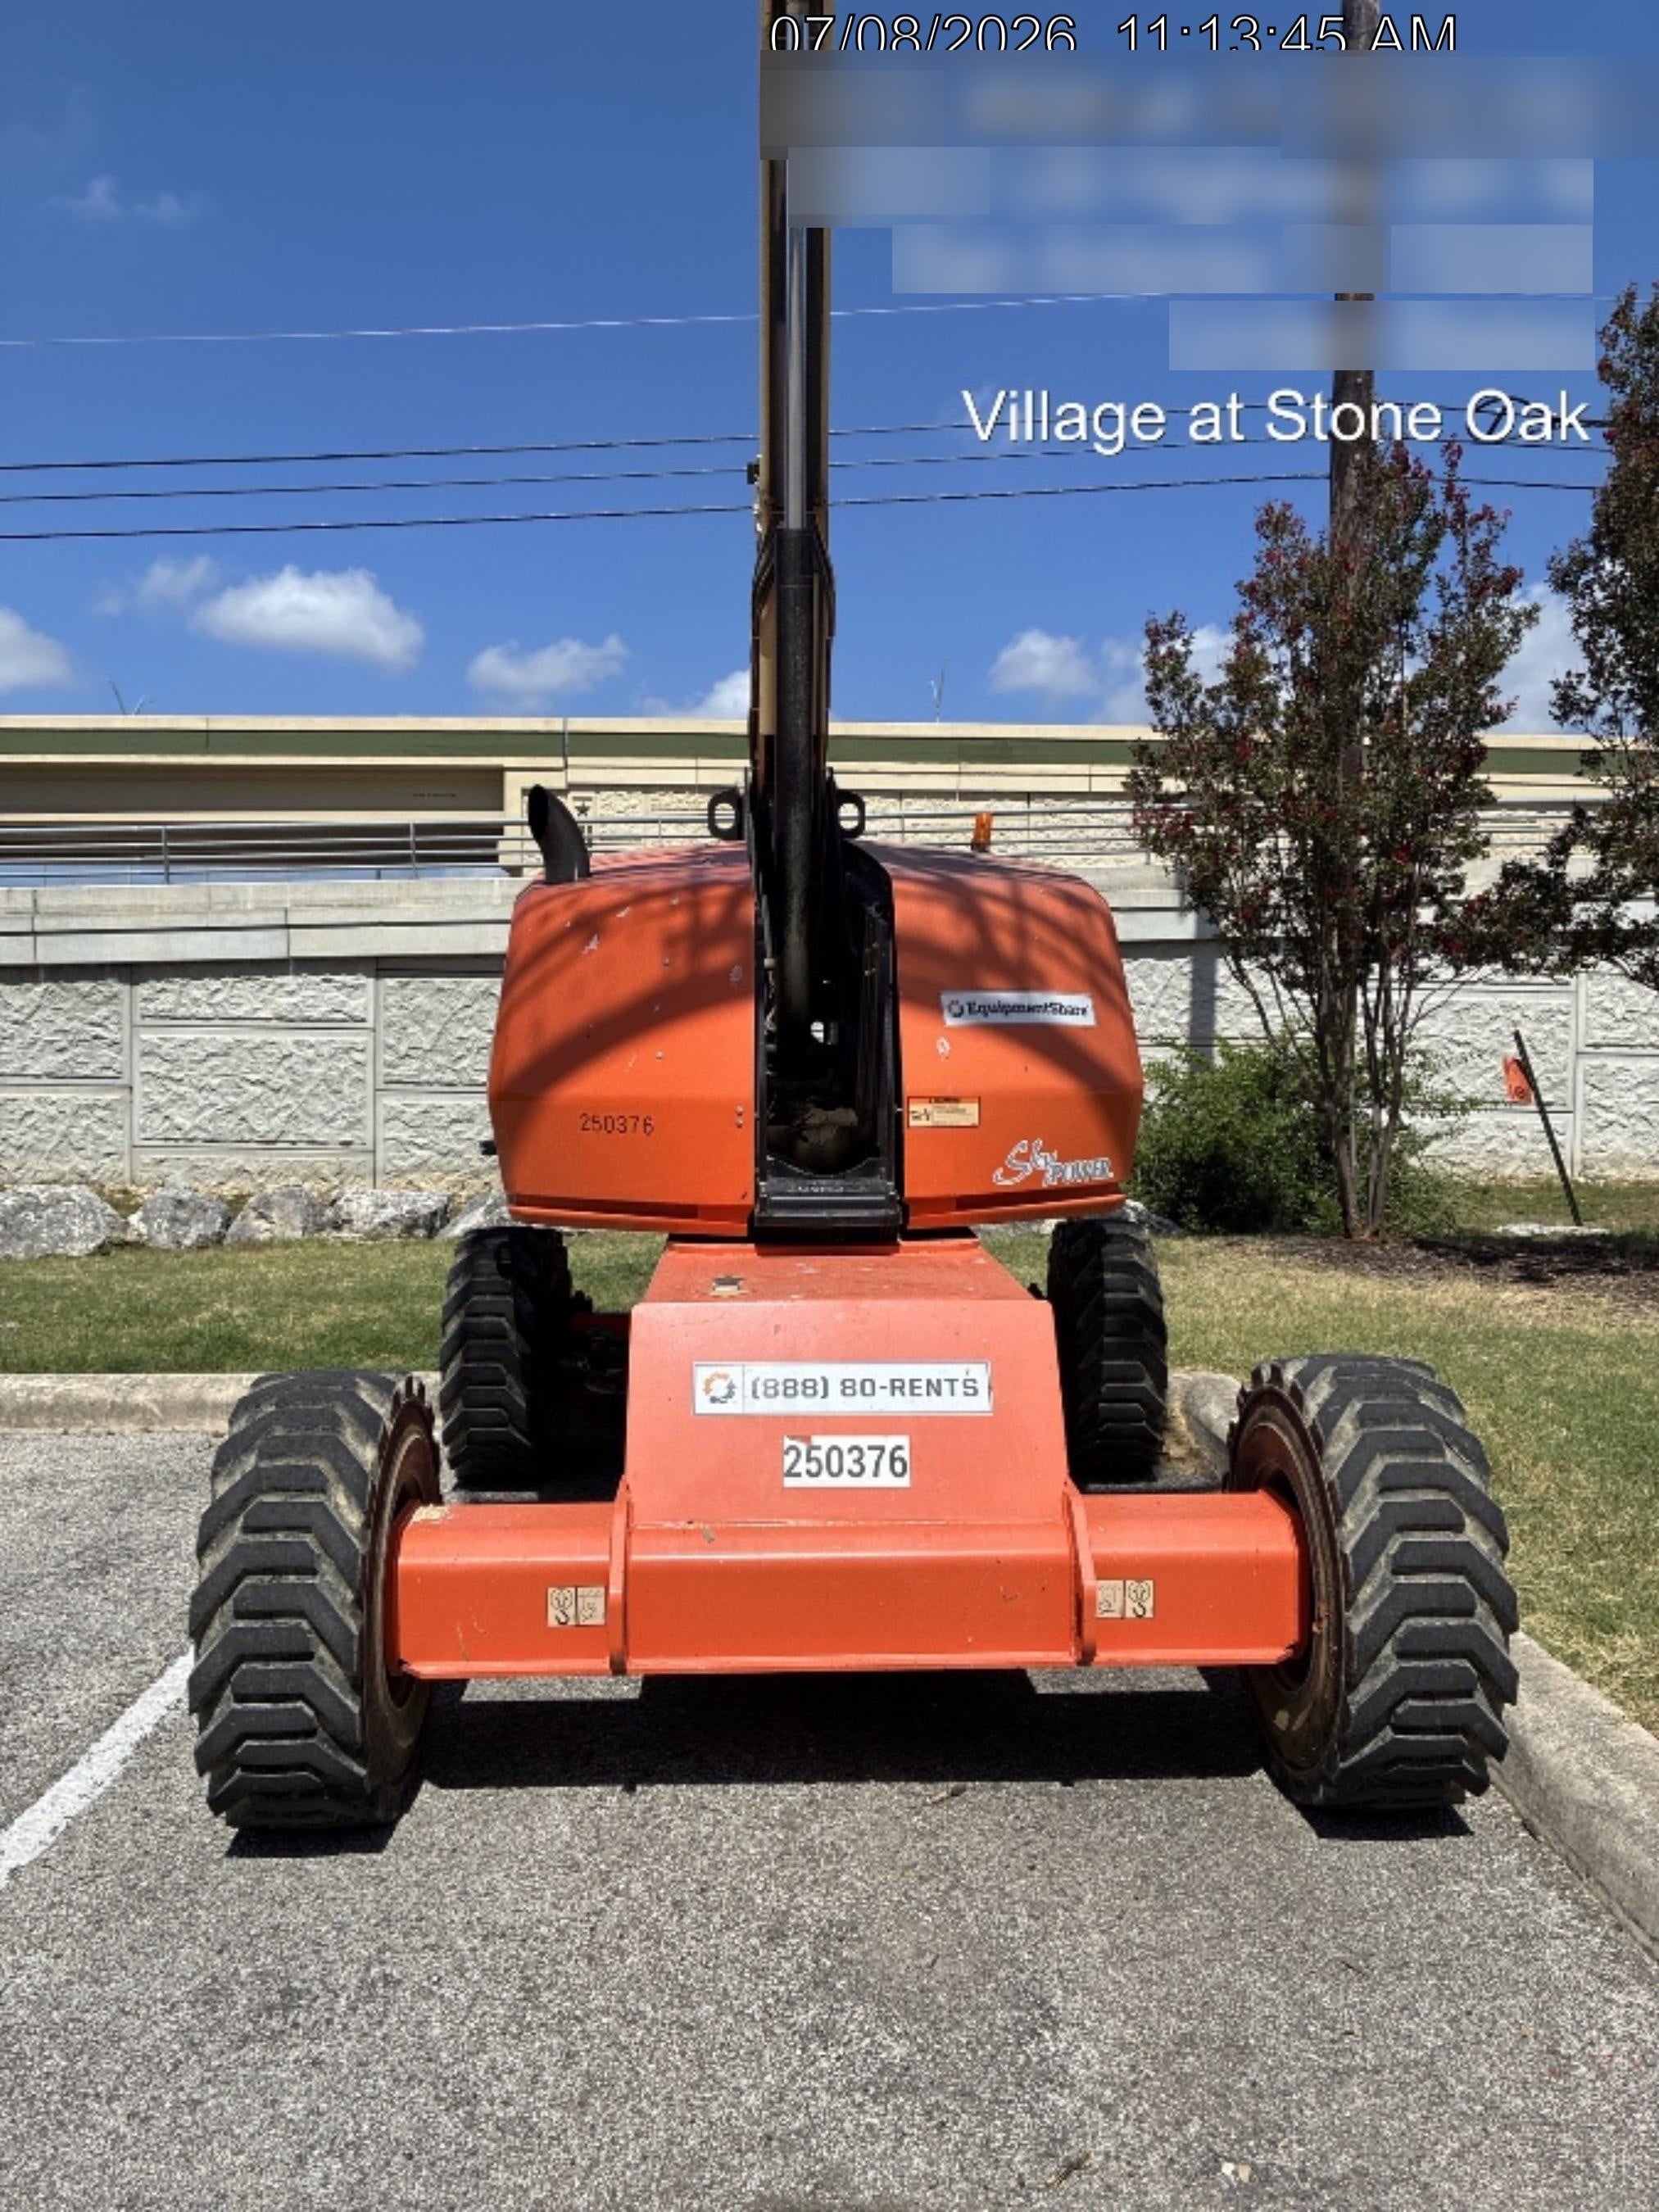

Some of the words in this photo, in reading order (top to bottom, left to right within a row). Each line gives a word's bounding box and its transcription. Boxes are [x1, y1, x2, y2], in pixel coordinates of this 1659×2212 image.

[579, 1113, 655, 1136] 250376
[750, 1376, 830, 1399] (888)
[840, 1377, 979, 1398] 80-RENTS
[782, 1444, 908, 1479] 250376
